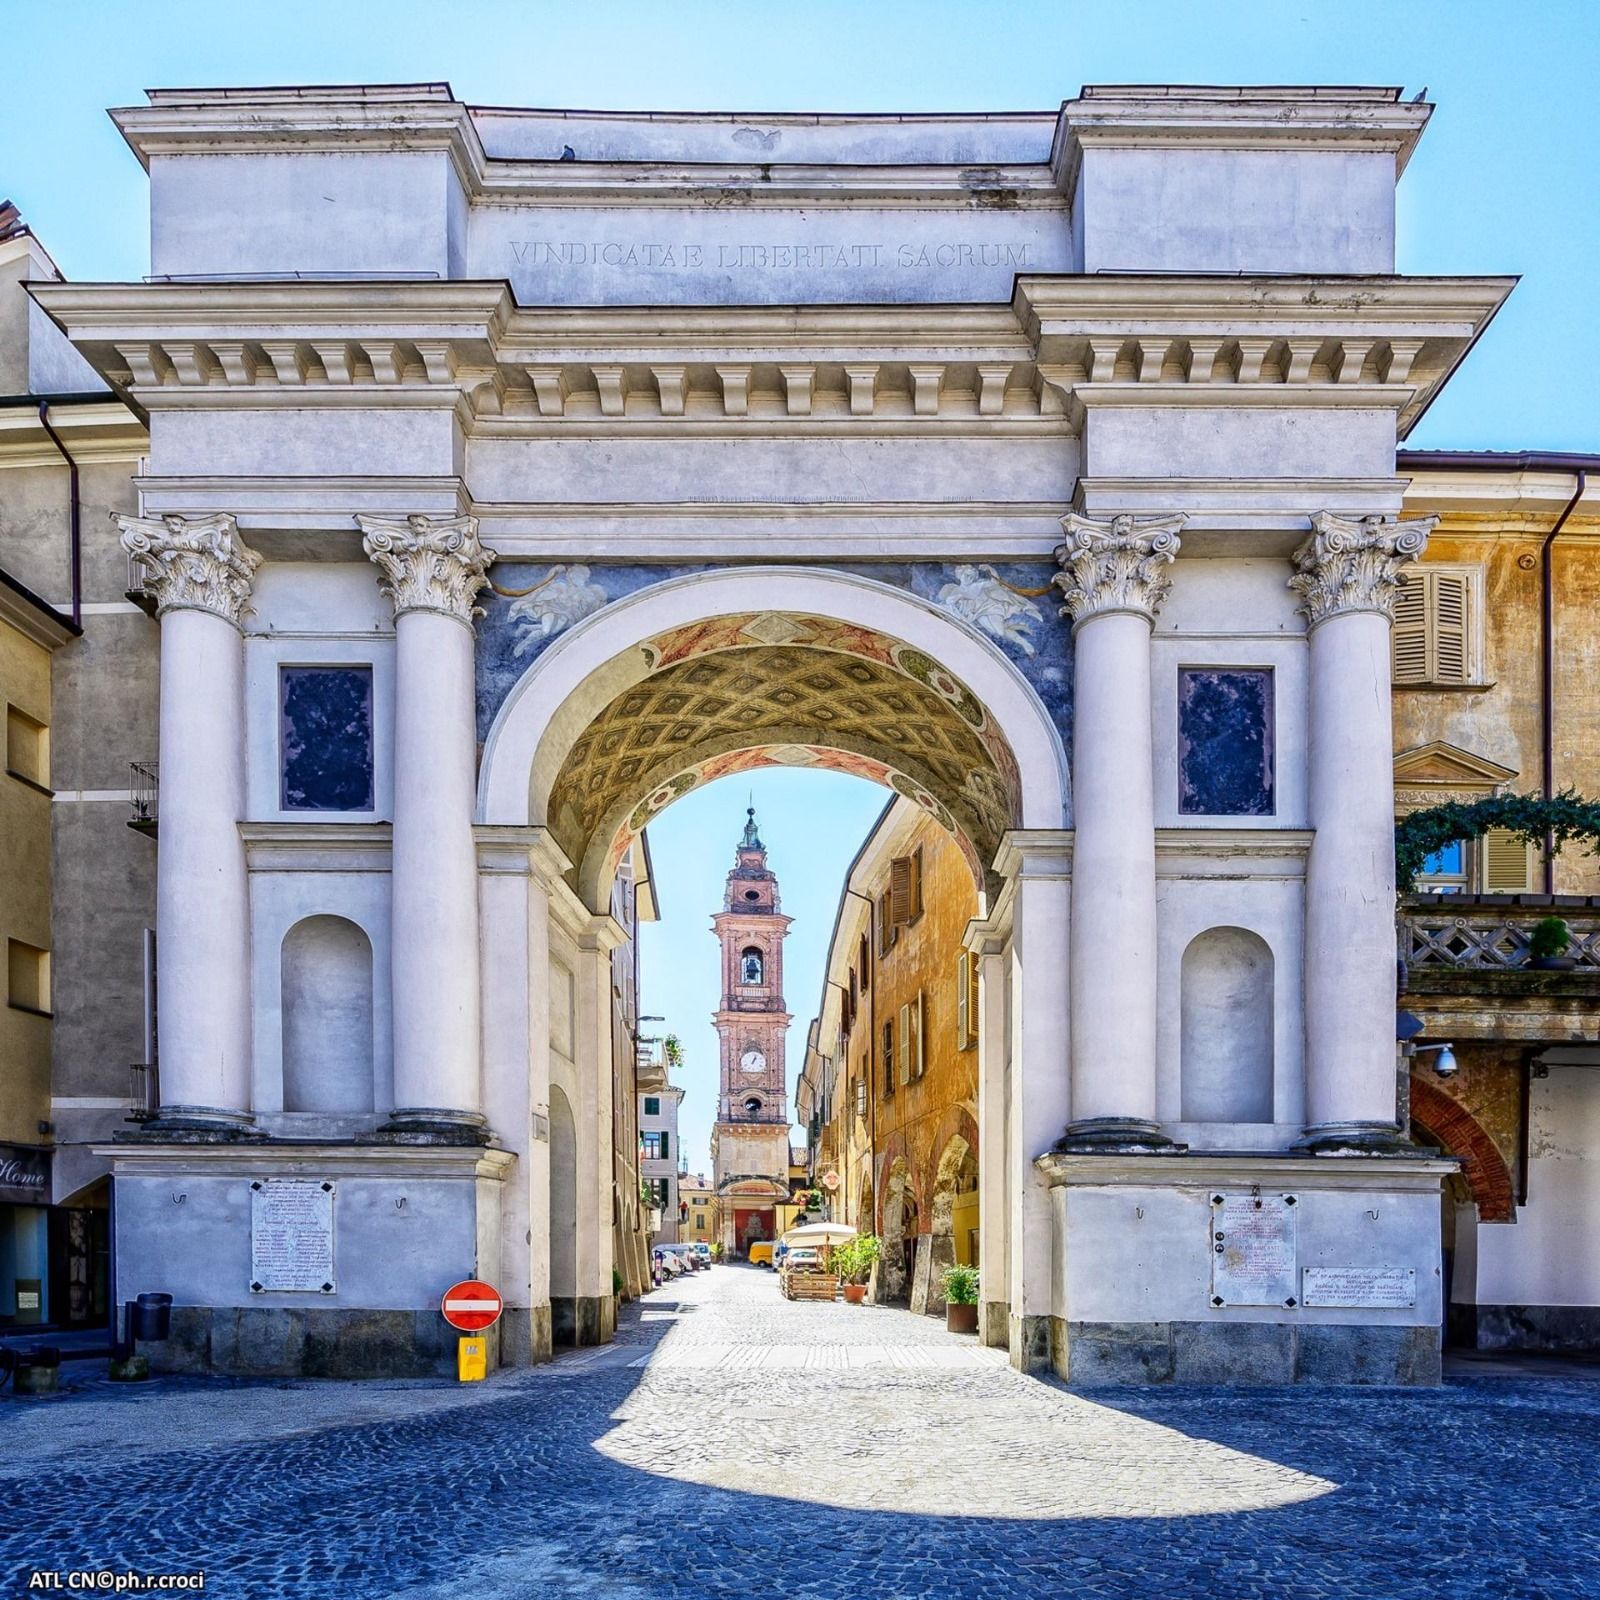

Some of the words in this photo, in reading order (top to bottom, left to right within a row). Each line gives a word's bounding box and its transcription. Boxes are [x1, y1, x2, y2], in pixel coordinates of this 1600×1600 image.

[509, 241, 704, 268] VINDICATAE
[716, 244, 885, 268] LIBERTATI
[896, 243, 1034, 268] SACRUM
[0, 1158, 45, 1185] Home
